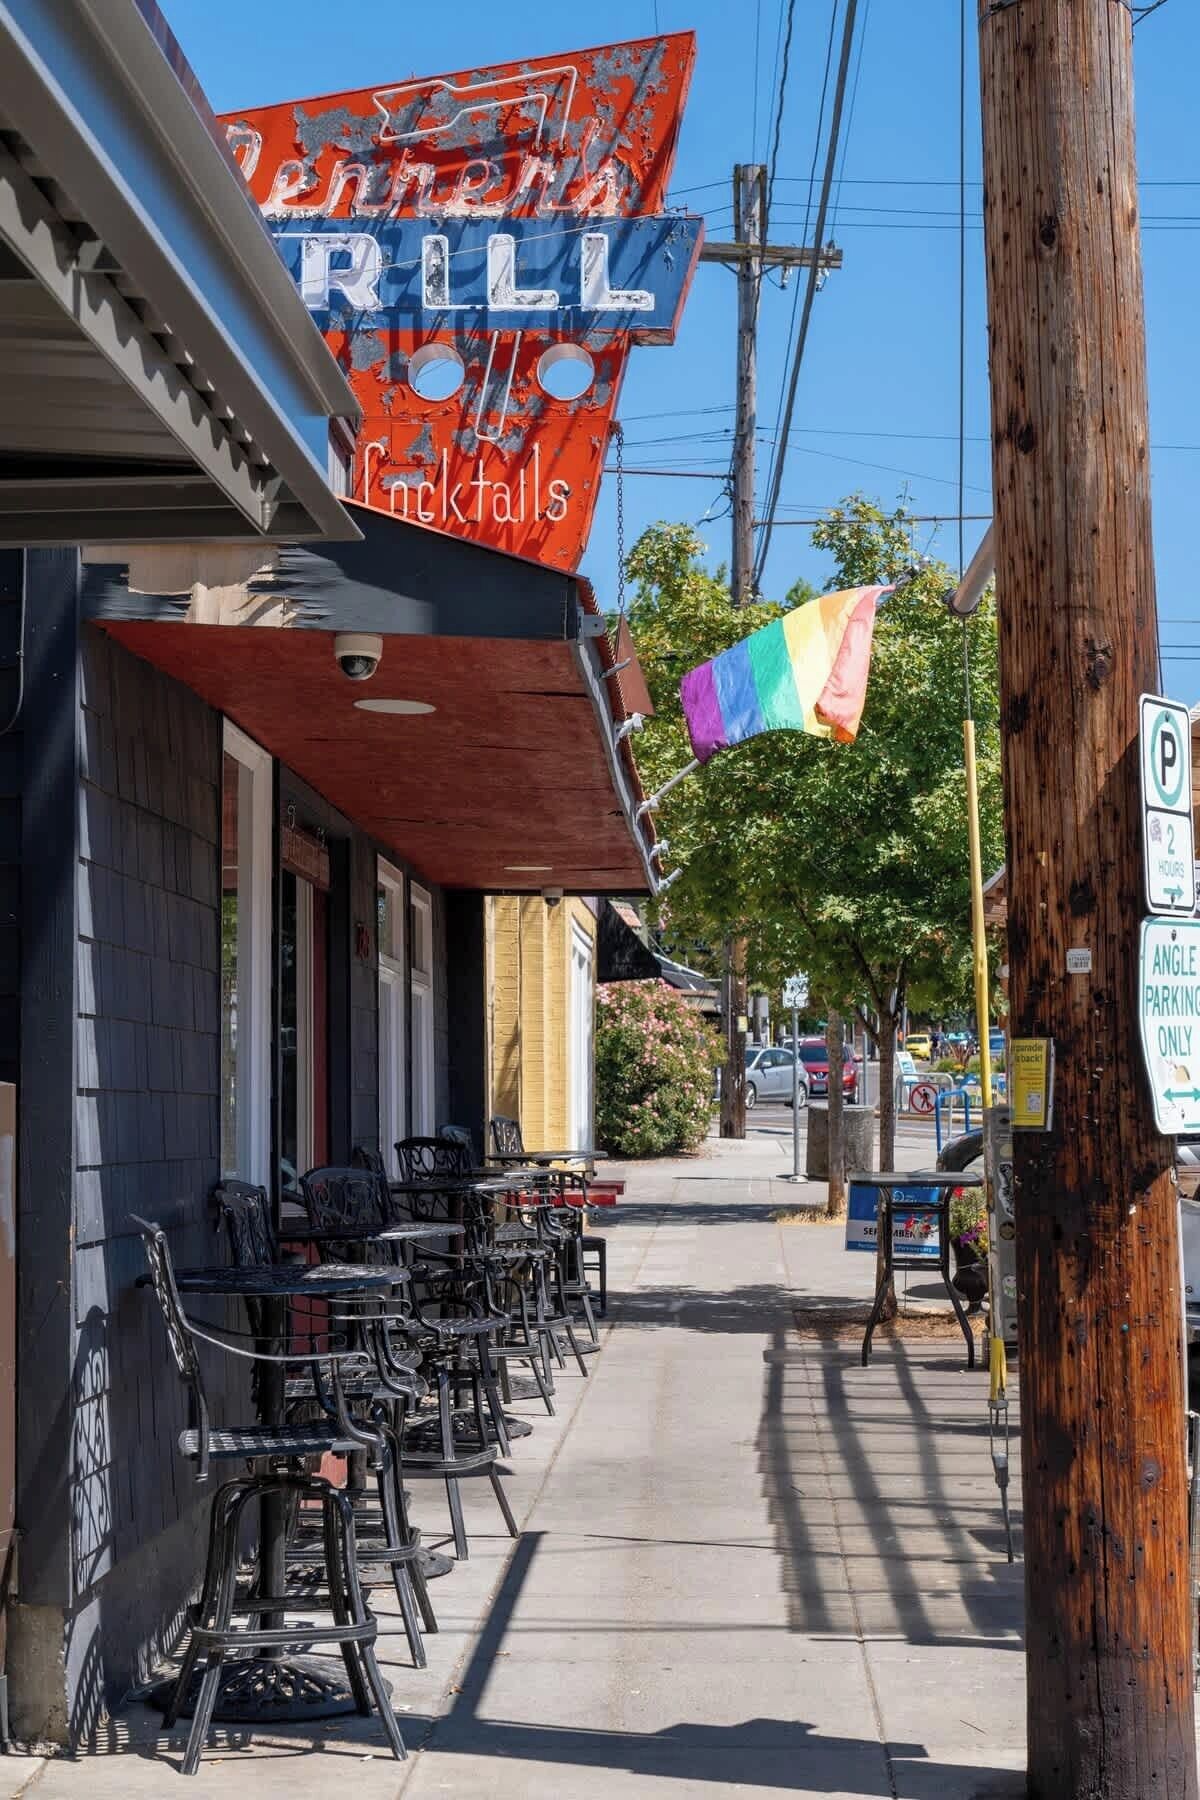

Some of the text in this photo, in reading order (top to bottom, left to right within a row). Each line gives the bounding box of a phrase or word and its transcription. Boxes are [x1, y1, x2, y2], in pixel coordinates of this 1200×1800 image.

[1160, 729, 1177, 786] P
[1166, 823, 1176, 855] 2
[1158, 859, 1185, 879] HOURS
[1152, 944, 1197, 976] ANGLE
[1145, 985, 1200, 1017] PARKING
[1158, 1025, 1192, 1057] ONLY
